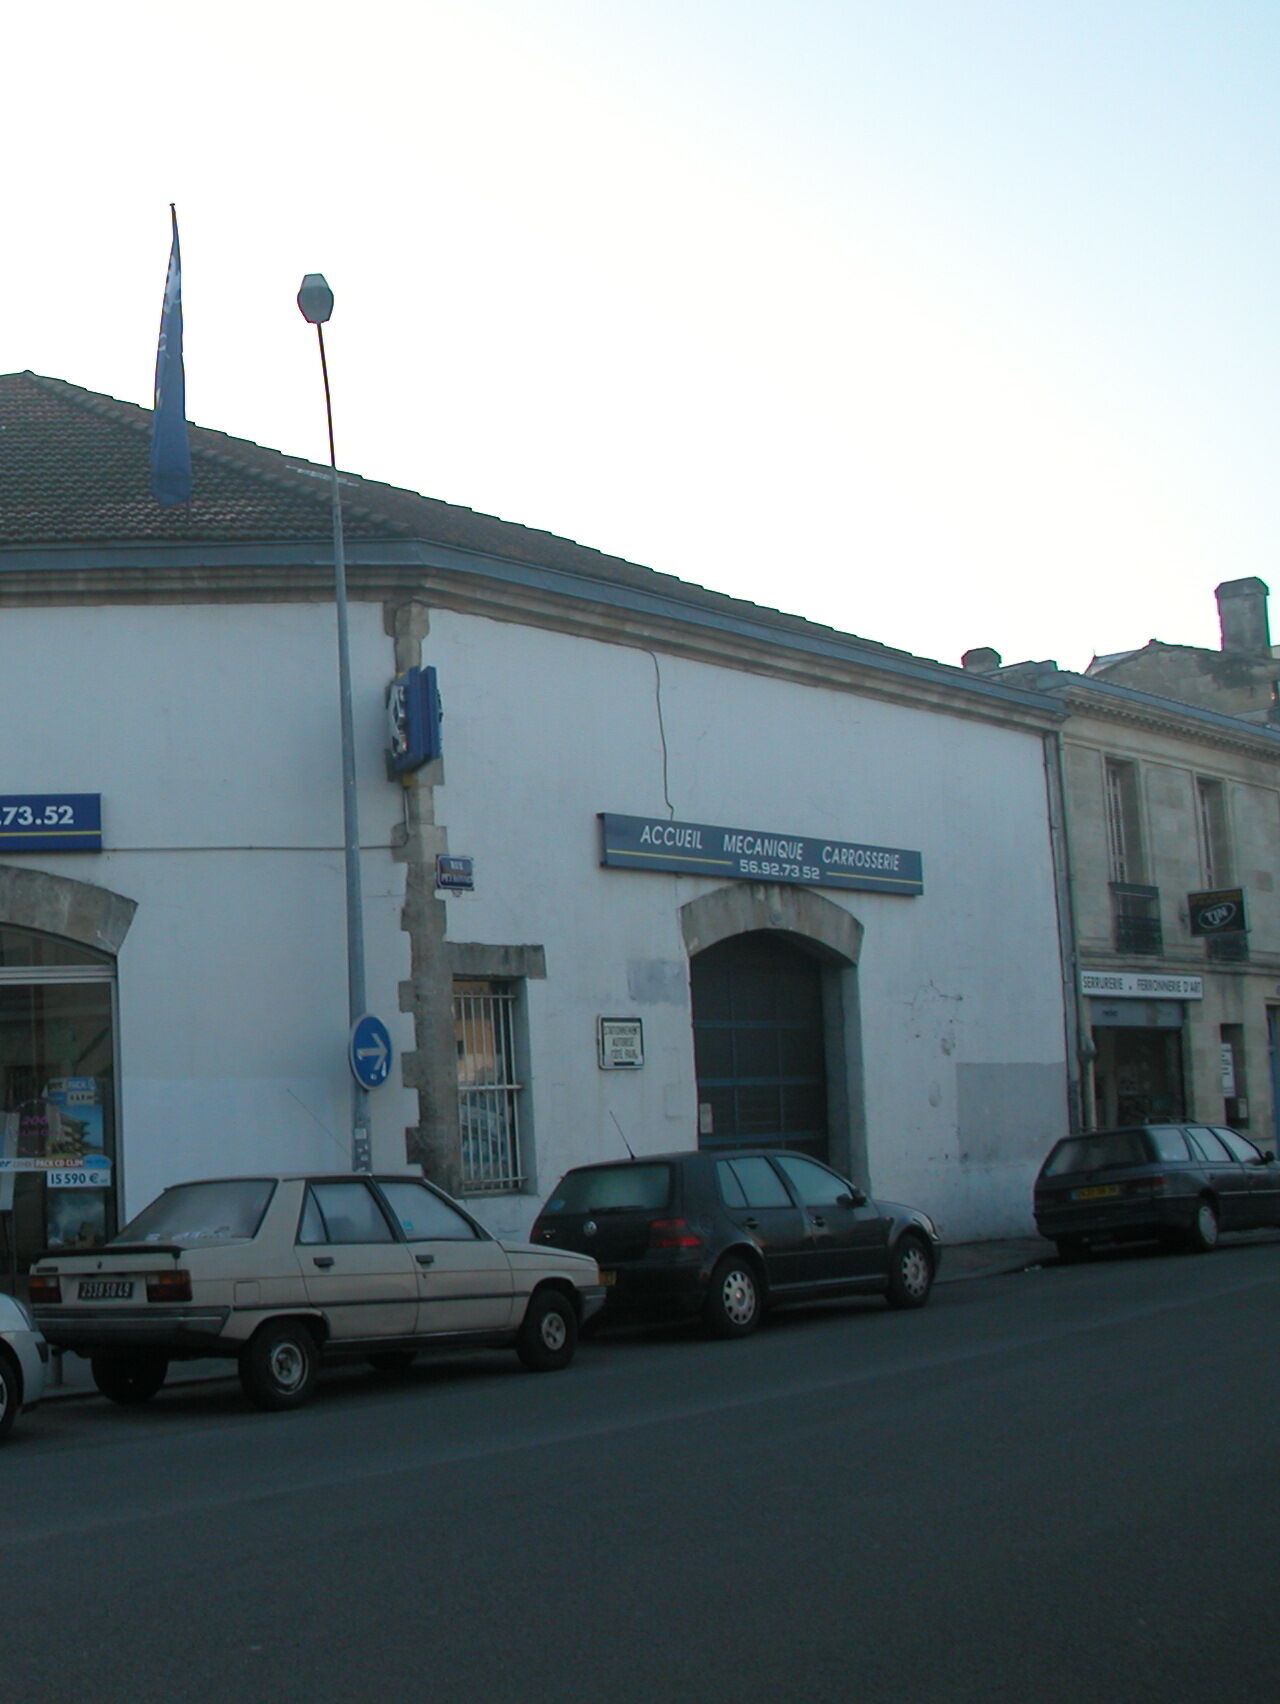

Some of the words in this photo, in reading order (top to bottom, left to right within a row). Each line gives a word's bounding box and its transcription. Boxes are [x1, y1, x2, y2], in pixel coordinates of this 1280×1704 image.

[640, 825, 702, 849] ACCUEIL
[723, 834, 803, 861] MECANIQUE
[822, 846, 900, 871] CARROSSERIE
